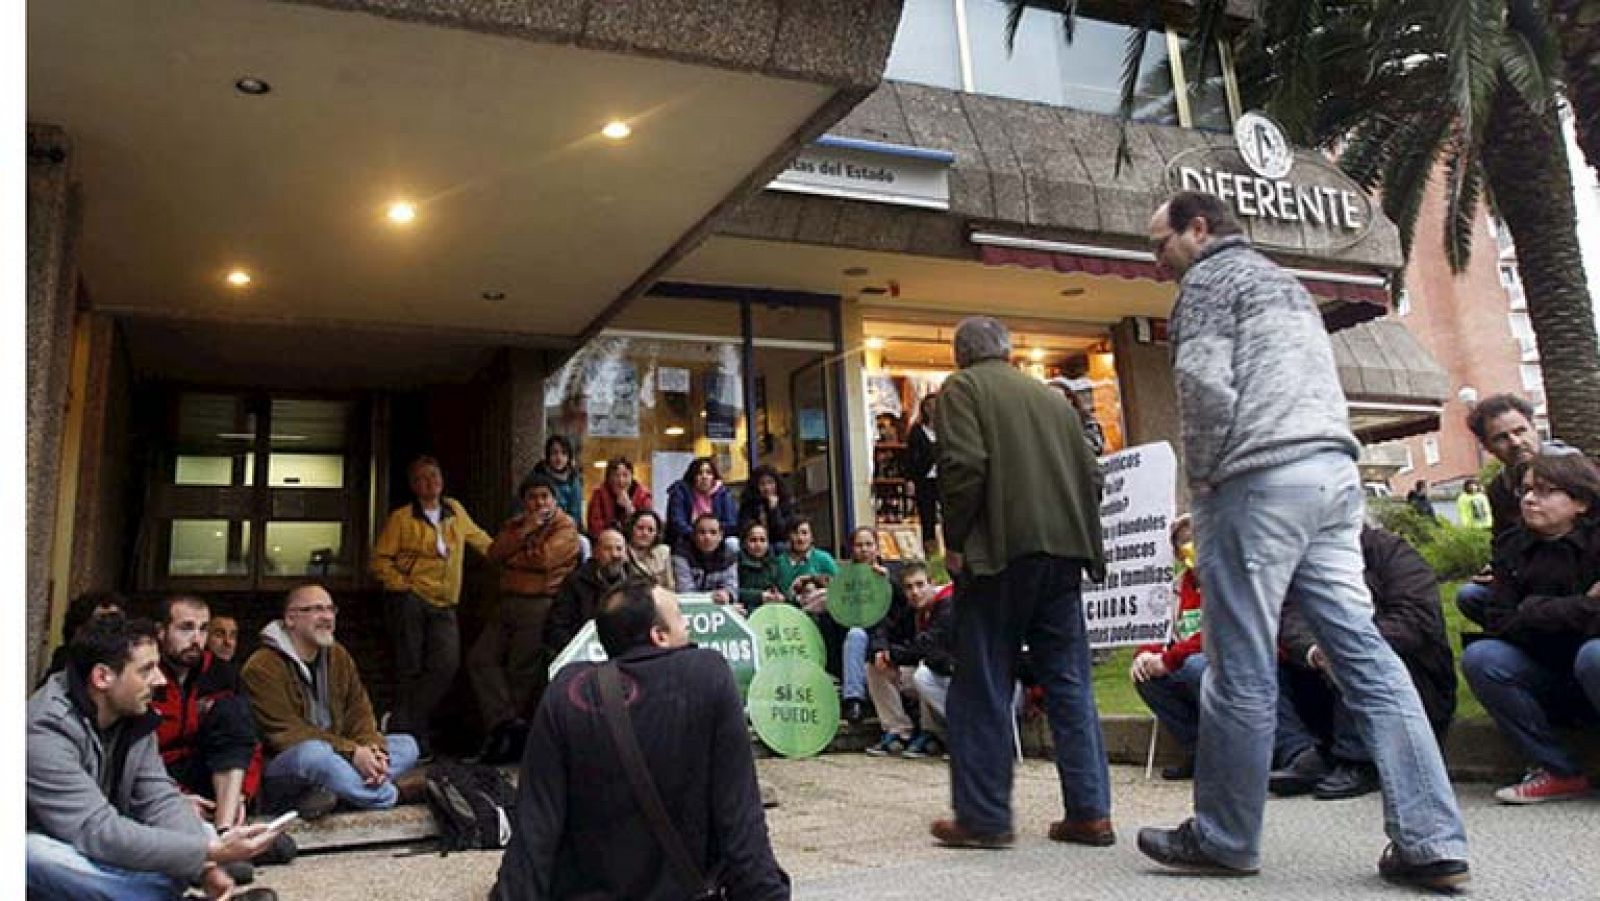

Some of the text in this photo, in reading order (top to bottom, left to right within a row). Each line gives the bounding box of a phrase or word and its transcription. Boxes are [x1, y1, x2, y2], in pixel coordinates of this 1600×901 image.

[819, 160, 842, 176] del
[846, 164, 895, 185] Estado
[771, 706, 819, 725] PUEDE
